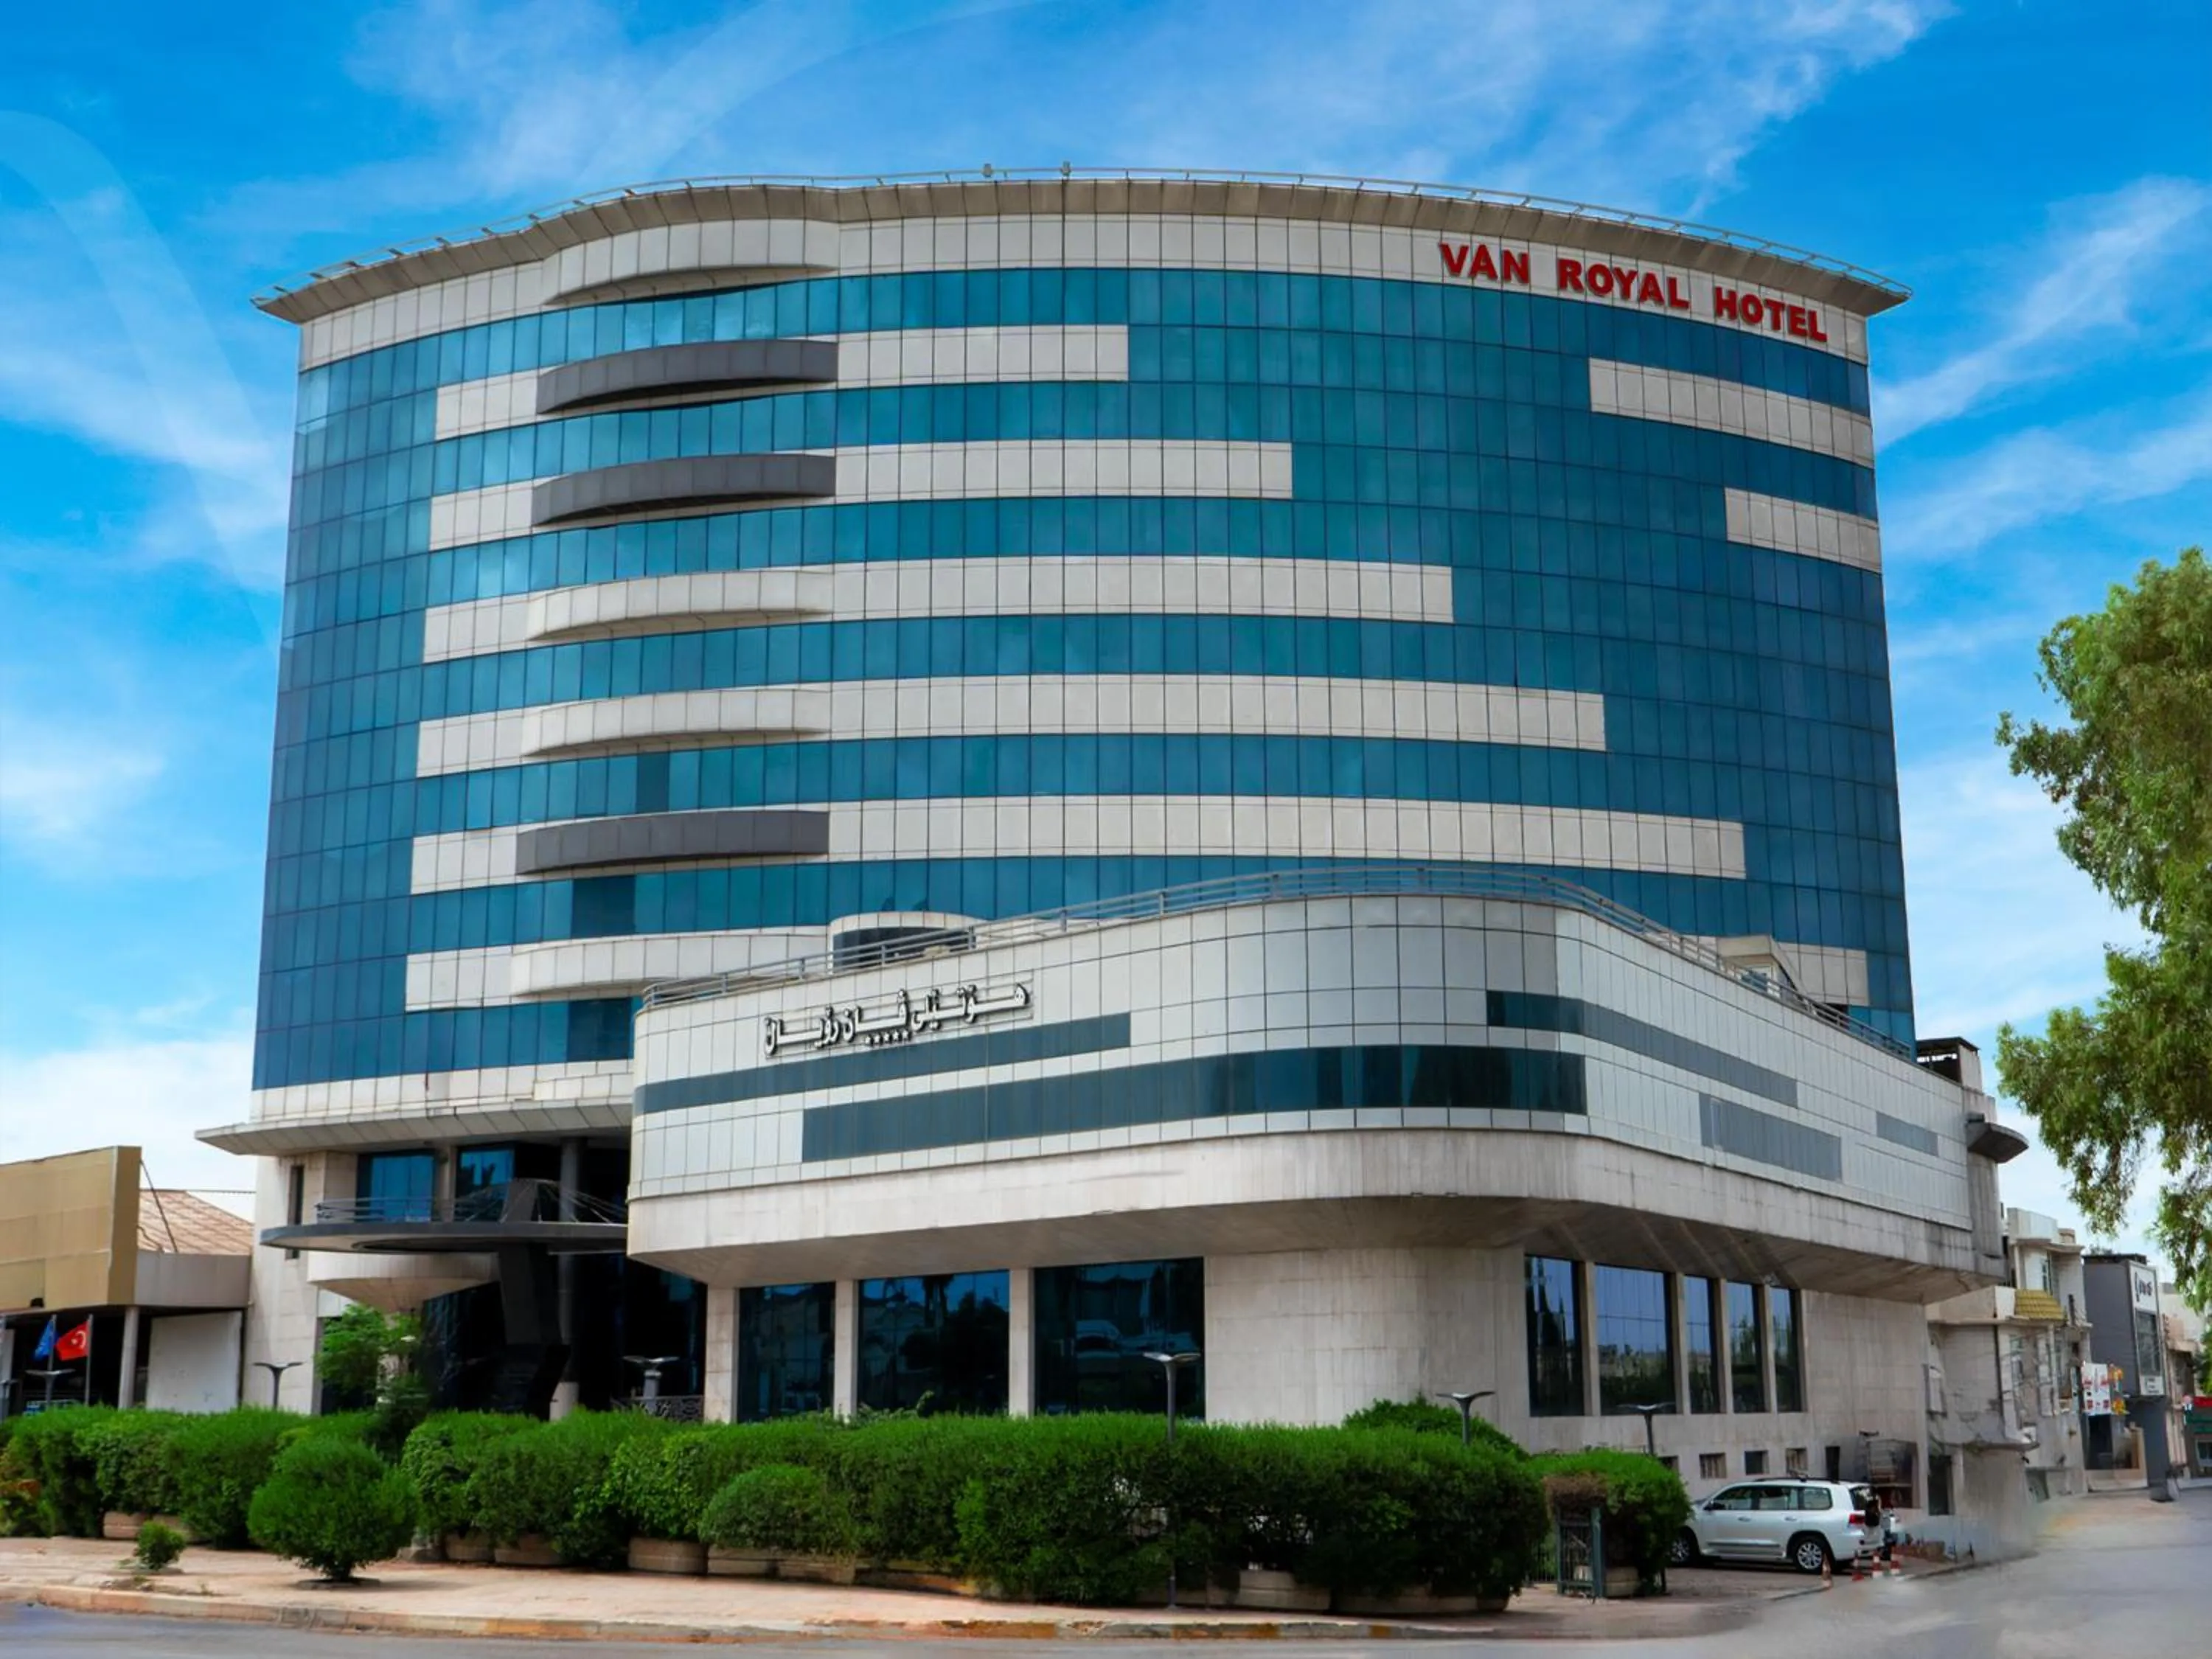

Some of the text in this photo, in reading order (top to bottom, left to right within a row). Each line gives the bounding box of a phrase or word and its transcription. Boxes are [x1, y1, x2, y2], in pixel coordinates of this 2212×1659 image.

[1440, 242, 1828, 342] VAN ROYAL HOTEL
